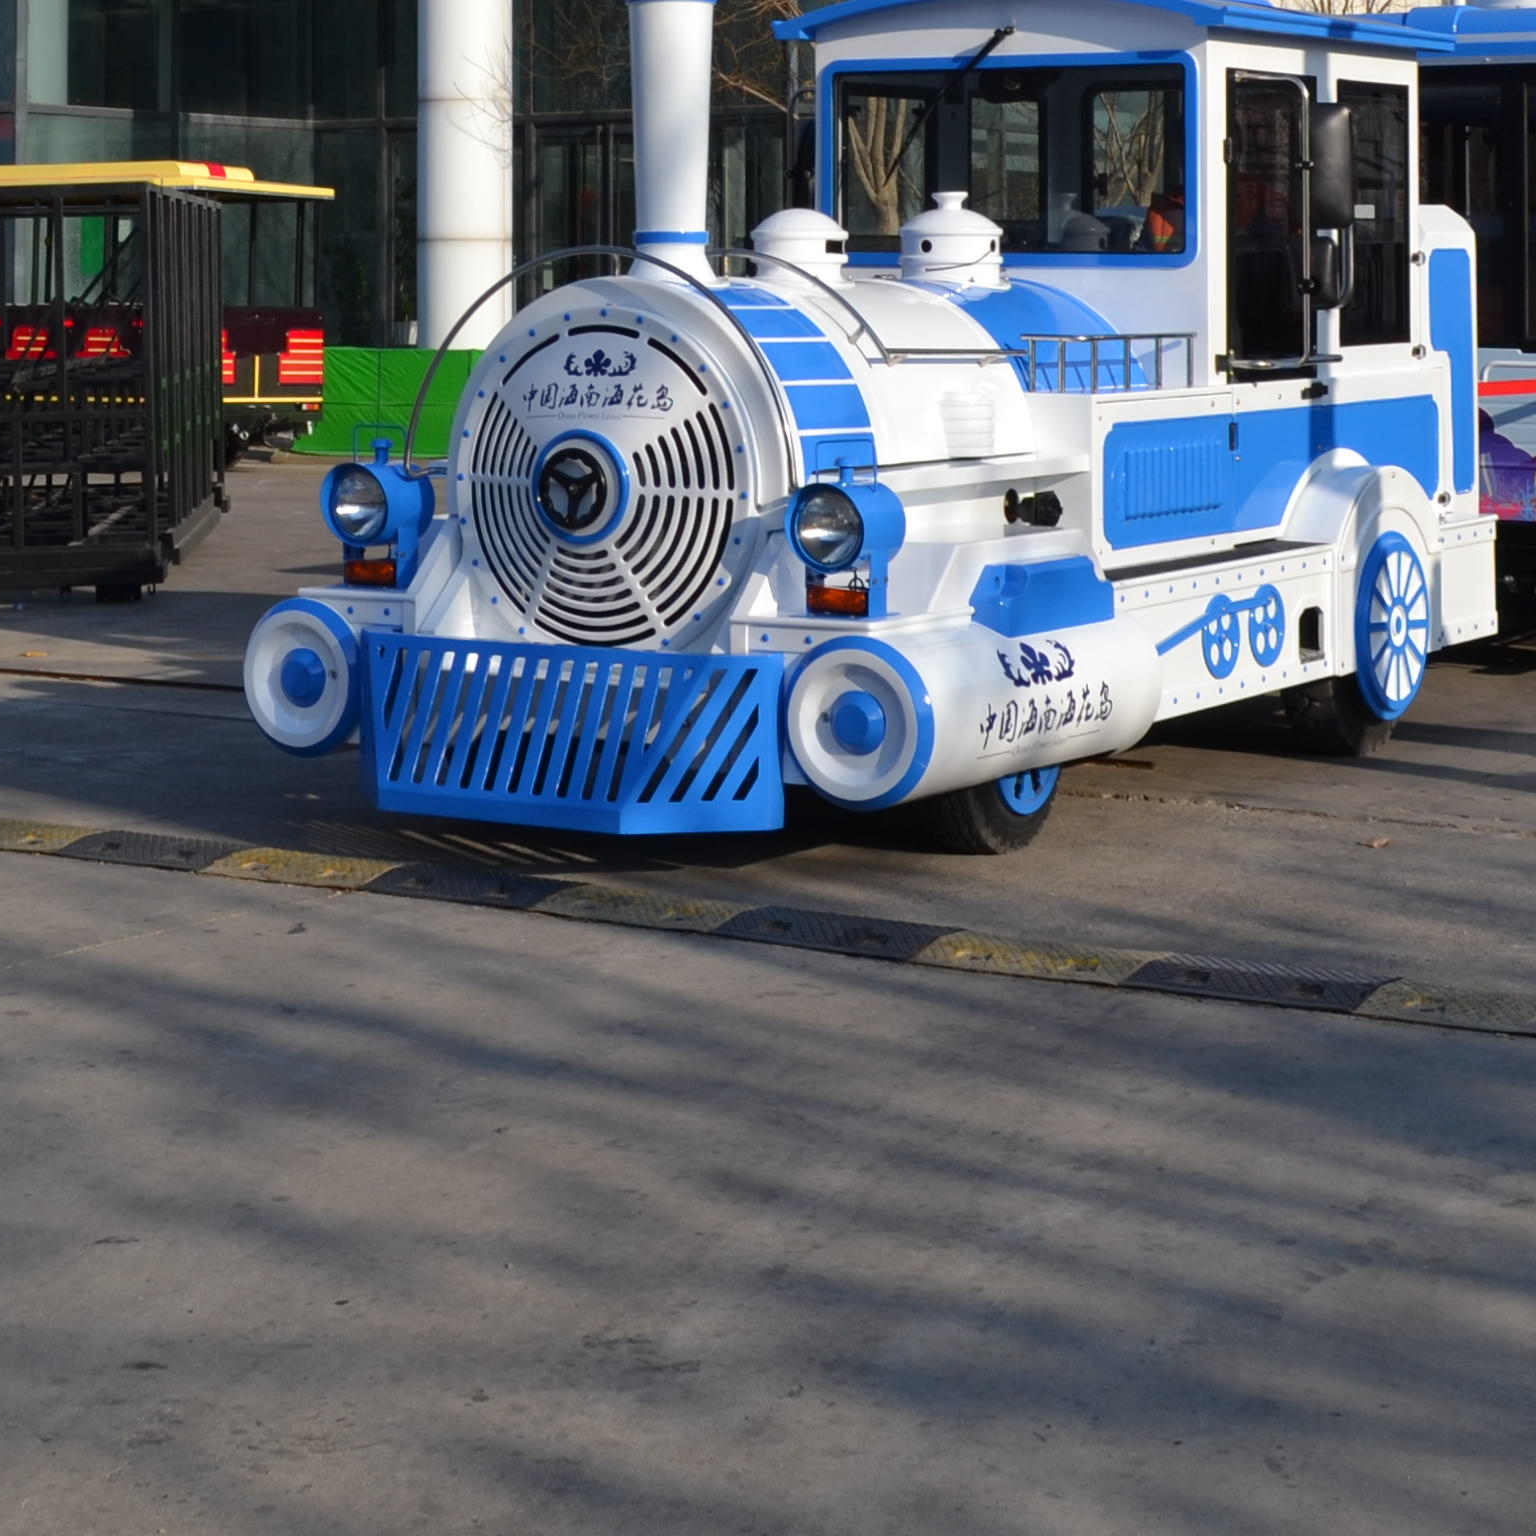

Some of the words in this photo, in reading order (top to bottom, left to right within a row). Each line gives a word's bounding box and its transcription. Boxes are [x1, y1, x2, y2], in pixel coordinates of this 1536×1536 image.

[523, 382, 674, 412] 中国海南海花岛
[980, 680, 1113, 750] 中国海南海花岛
